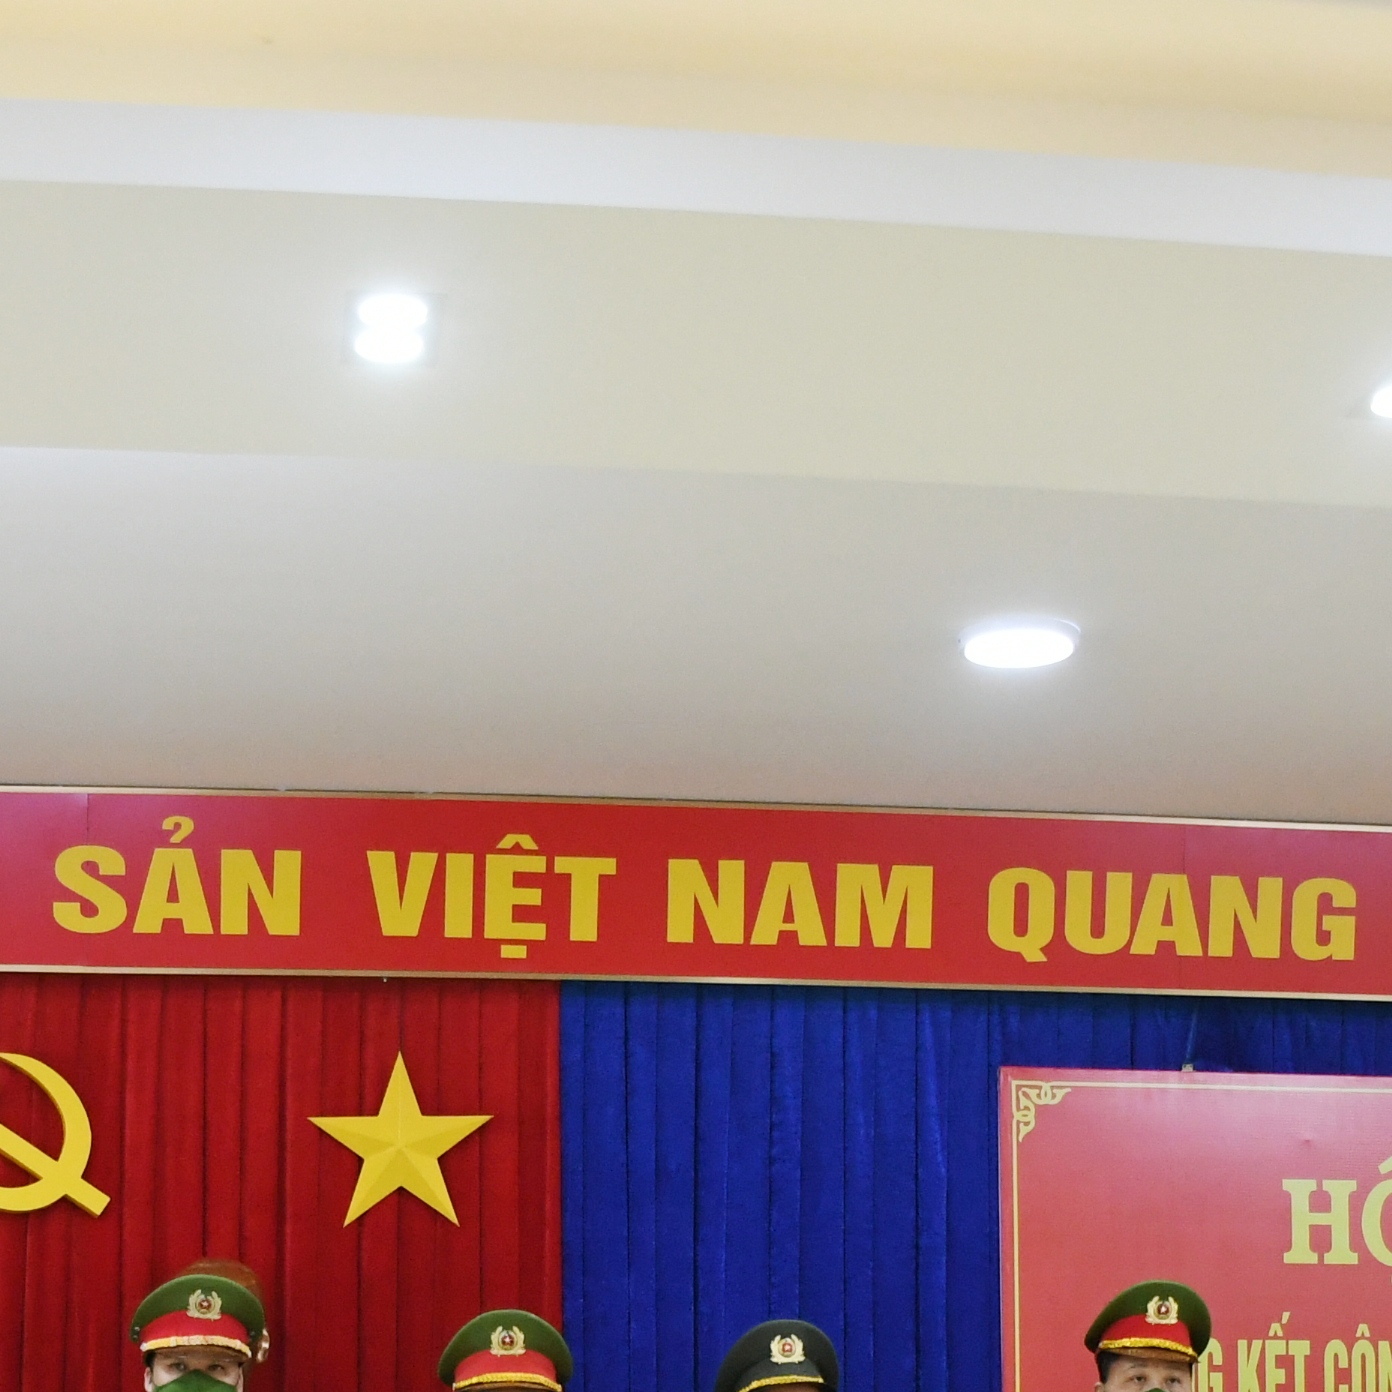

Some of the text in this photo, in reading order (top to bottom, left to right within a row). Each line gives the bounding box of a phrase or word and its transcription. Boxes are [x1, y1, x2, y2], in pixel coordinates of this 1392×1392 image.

[53, 816, 302, 936] SẢN
[367, 832, 617, 958] VIỆT
[667, 859, 934, 948] NAM
[987, 867, 1357, 962] QUANG
